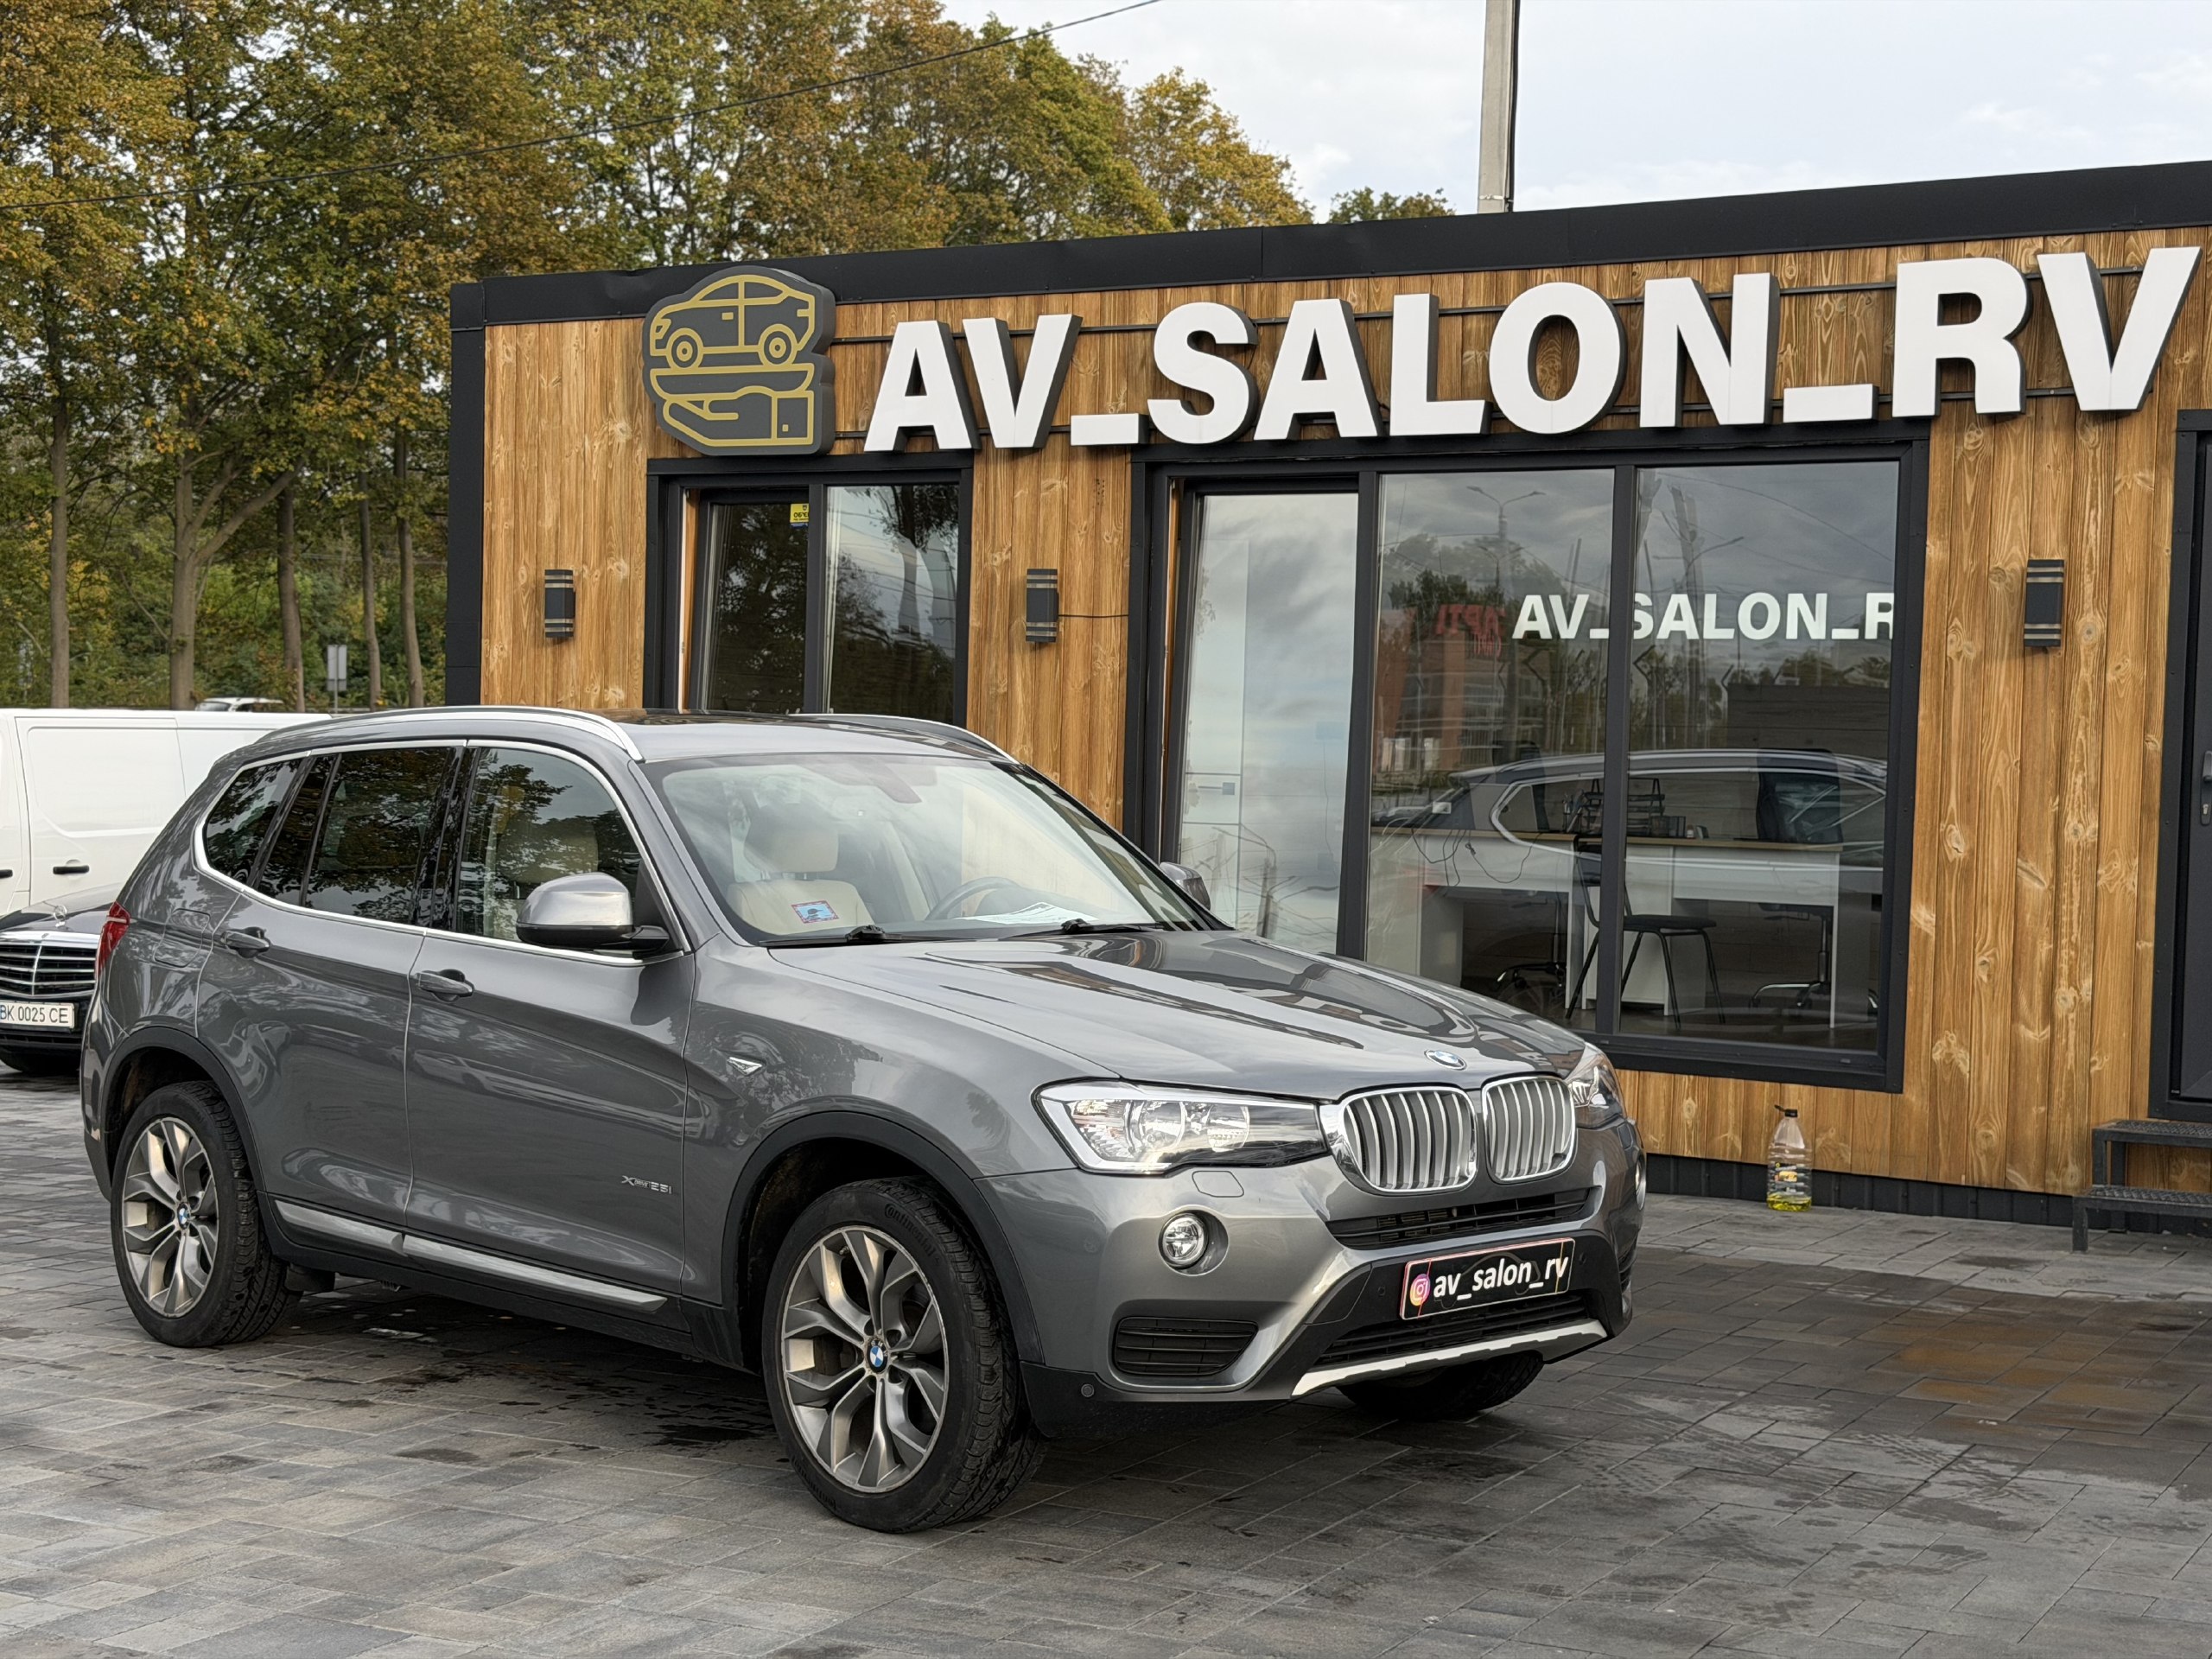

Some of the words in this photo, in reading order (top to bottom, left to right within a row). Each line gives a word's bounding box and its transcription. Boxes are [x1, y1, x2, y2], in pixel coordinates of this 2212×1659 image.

[864, 246, 2202, 453] AV_SALON_RV
[0, 1005, 15, 1021] BK
[18, 1006, 46, 1022] 0025
[49, 1007, 69, 1024] CE
[1433, 1256, 1569, 1301] av_salon_rv
